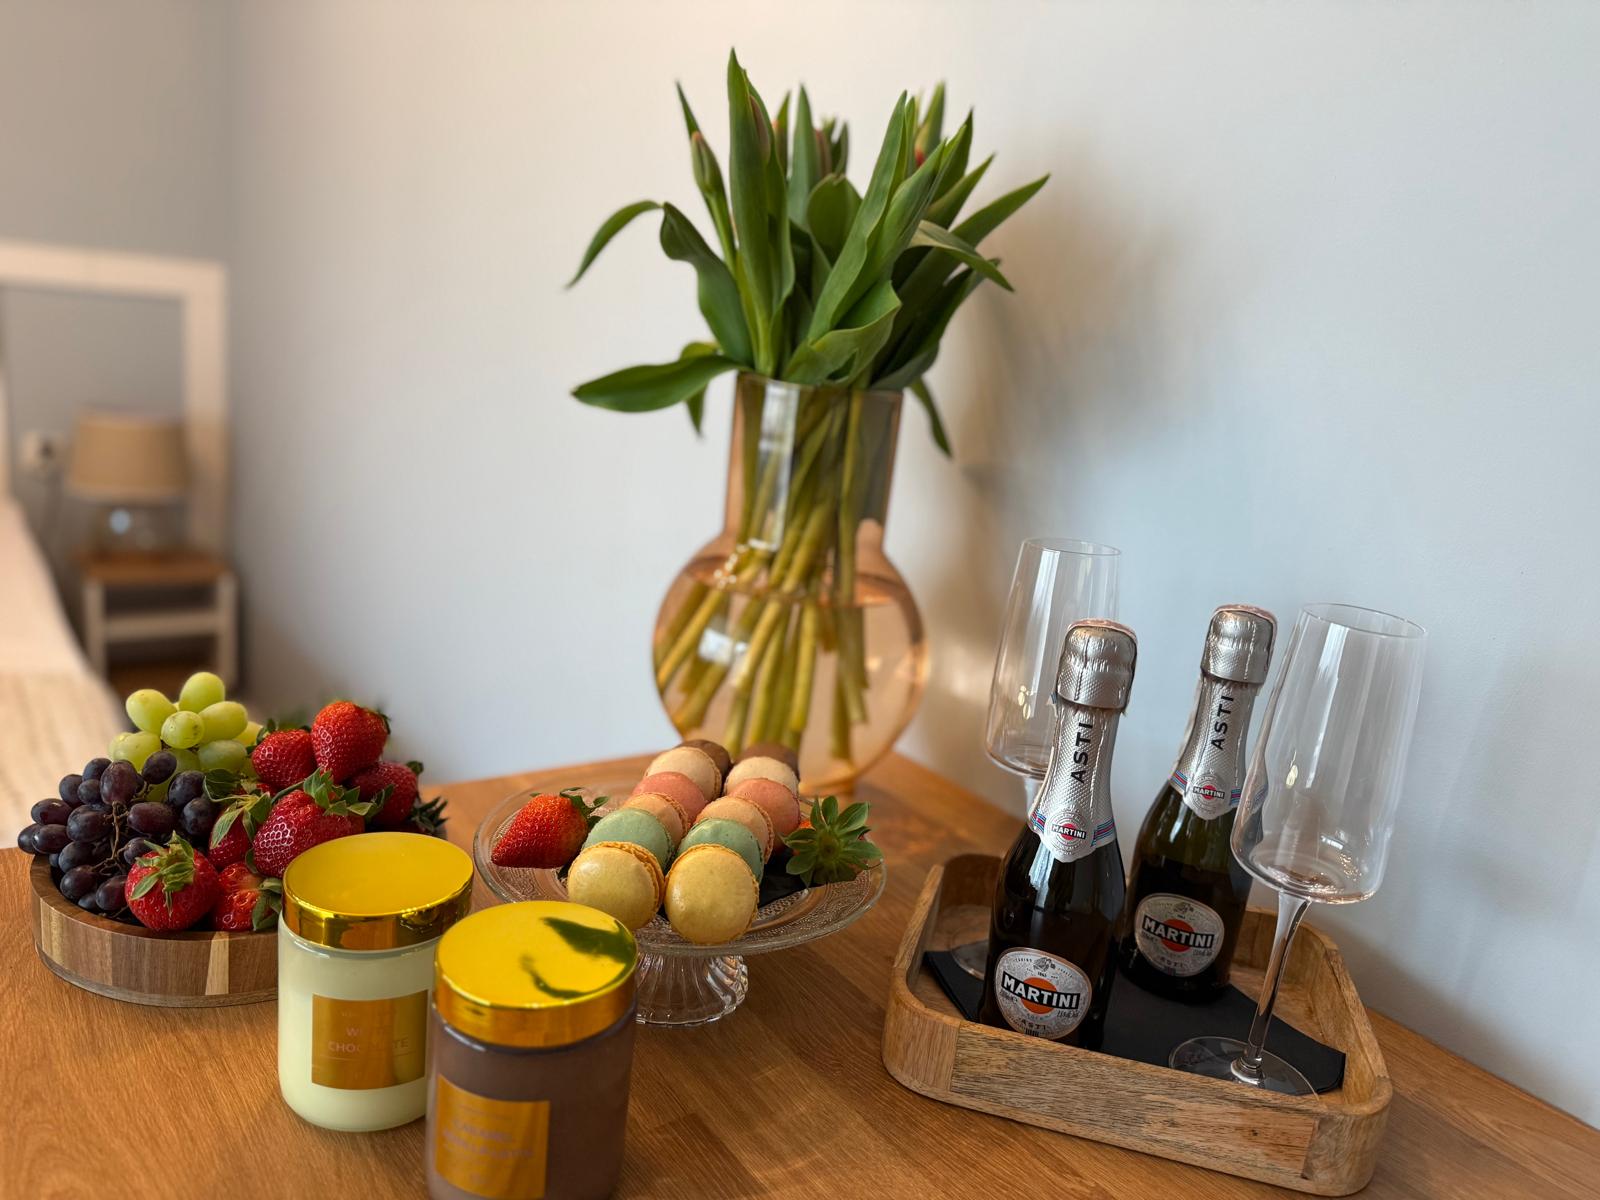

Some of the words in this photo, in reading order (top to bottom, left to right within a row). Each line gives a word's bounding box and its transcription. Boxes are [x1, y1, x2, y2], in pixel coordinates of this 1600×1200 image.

[1211, 695, 1234, 751] ASTI
[1070, 722, 1093, 784] ASTI
[1193, 786, 1224, 799] MARTINI
[1052, 824, 1086, 839] MARTINI
[1143, 917, 1213, 948] MARTINI
[1003, 973, 1079, 1009] MARTINI
